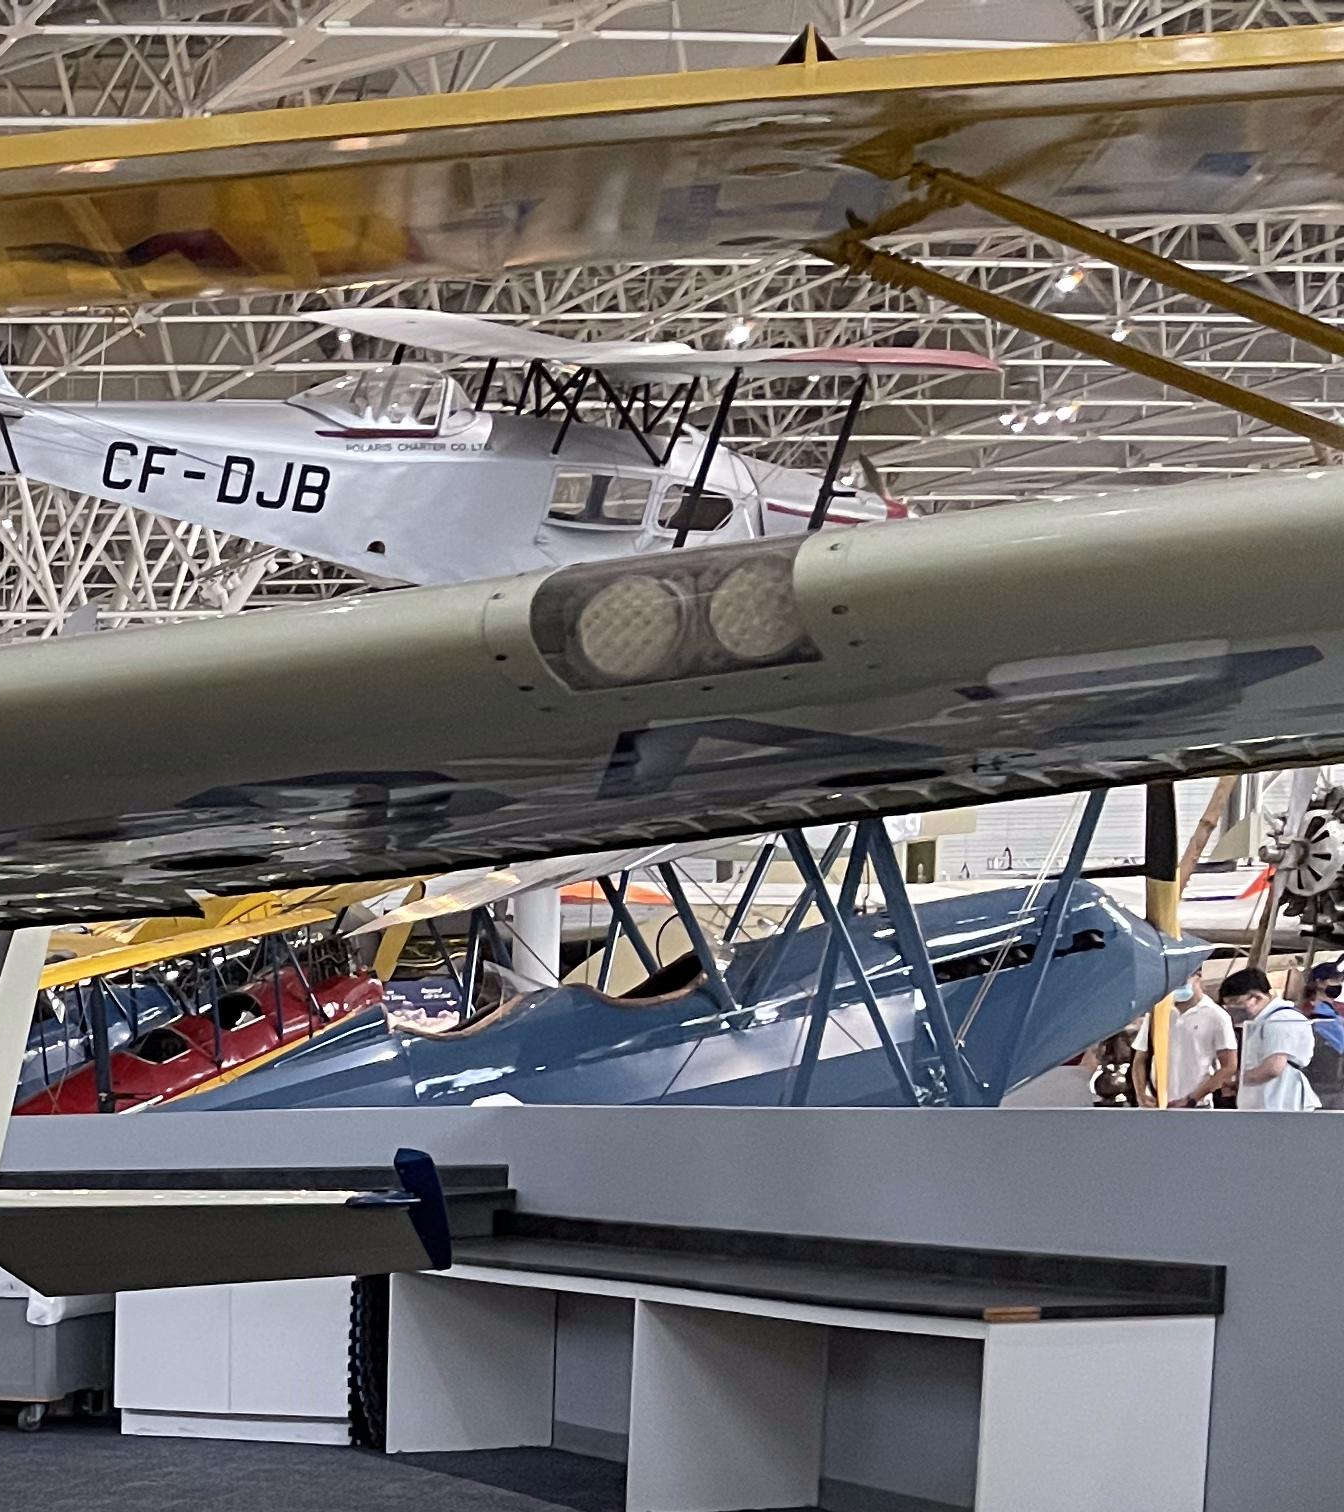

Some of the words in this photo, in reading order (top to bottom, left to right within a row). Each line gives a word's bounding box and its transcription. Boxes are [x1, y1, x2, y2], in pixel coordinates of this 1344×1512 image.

[345, 443, 392, 451] POLARIS
[397, 442, 446, 451] CHARTER
[102, 441, 331, 514] CF-DJB
